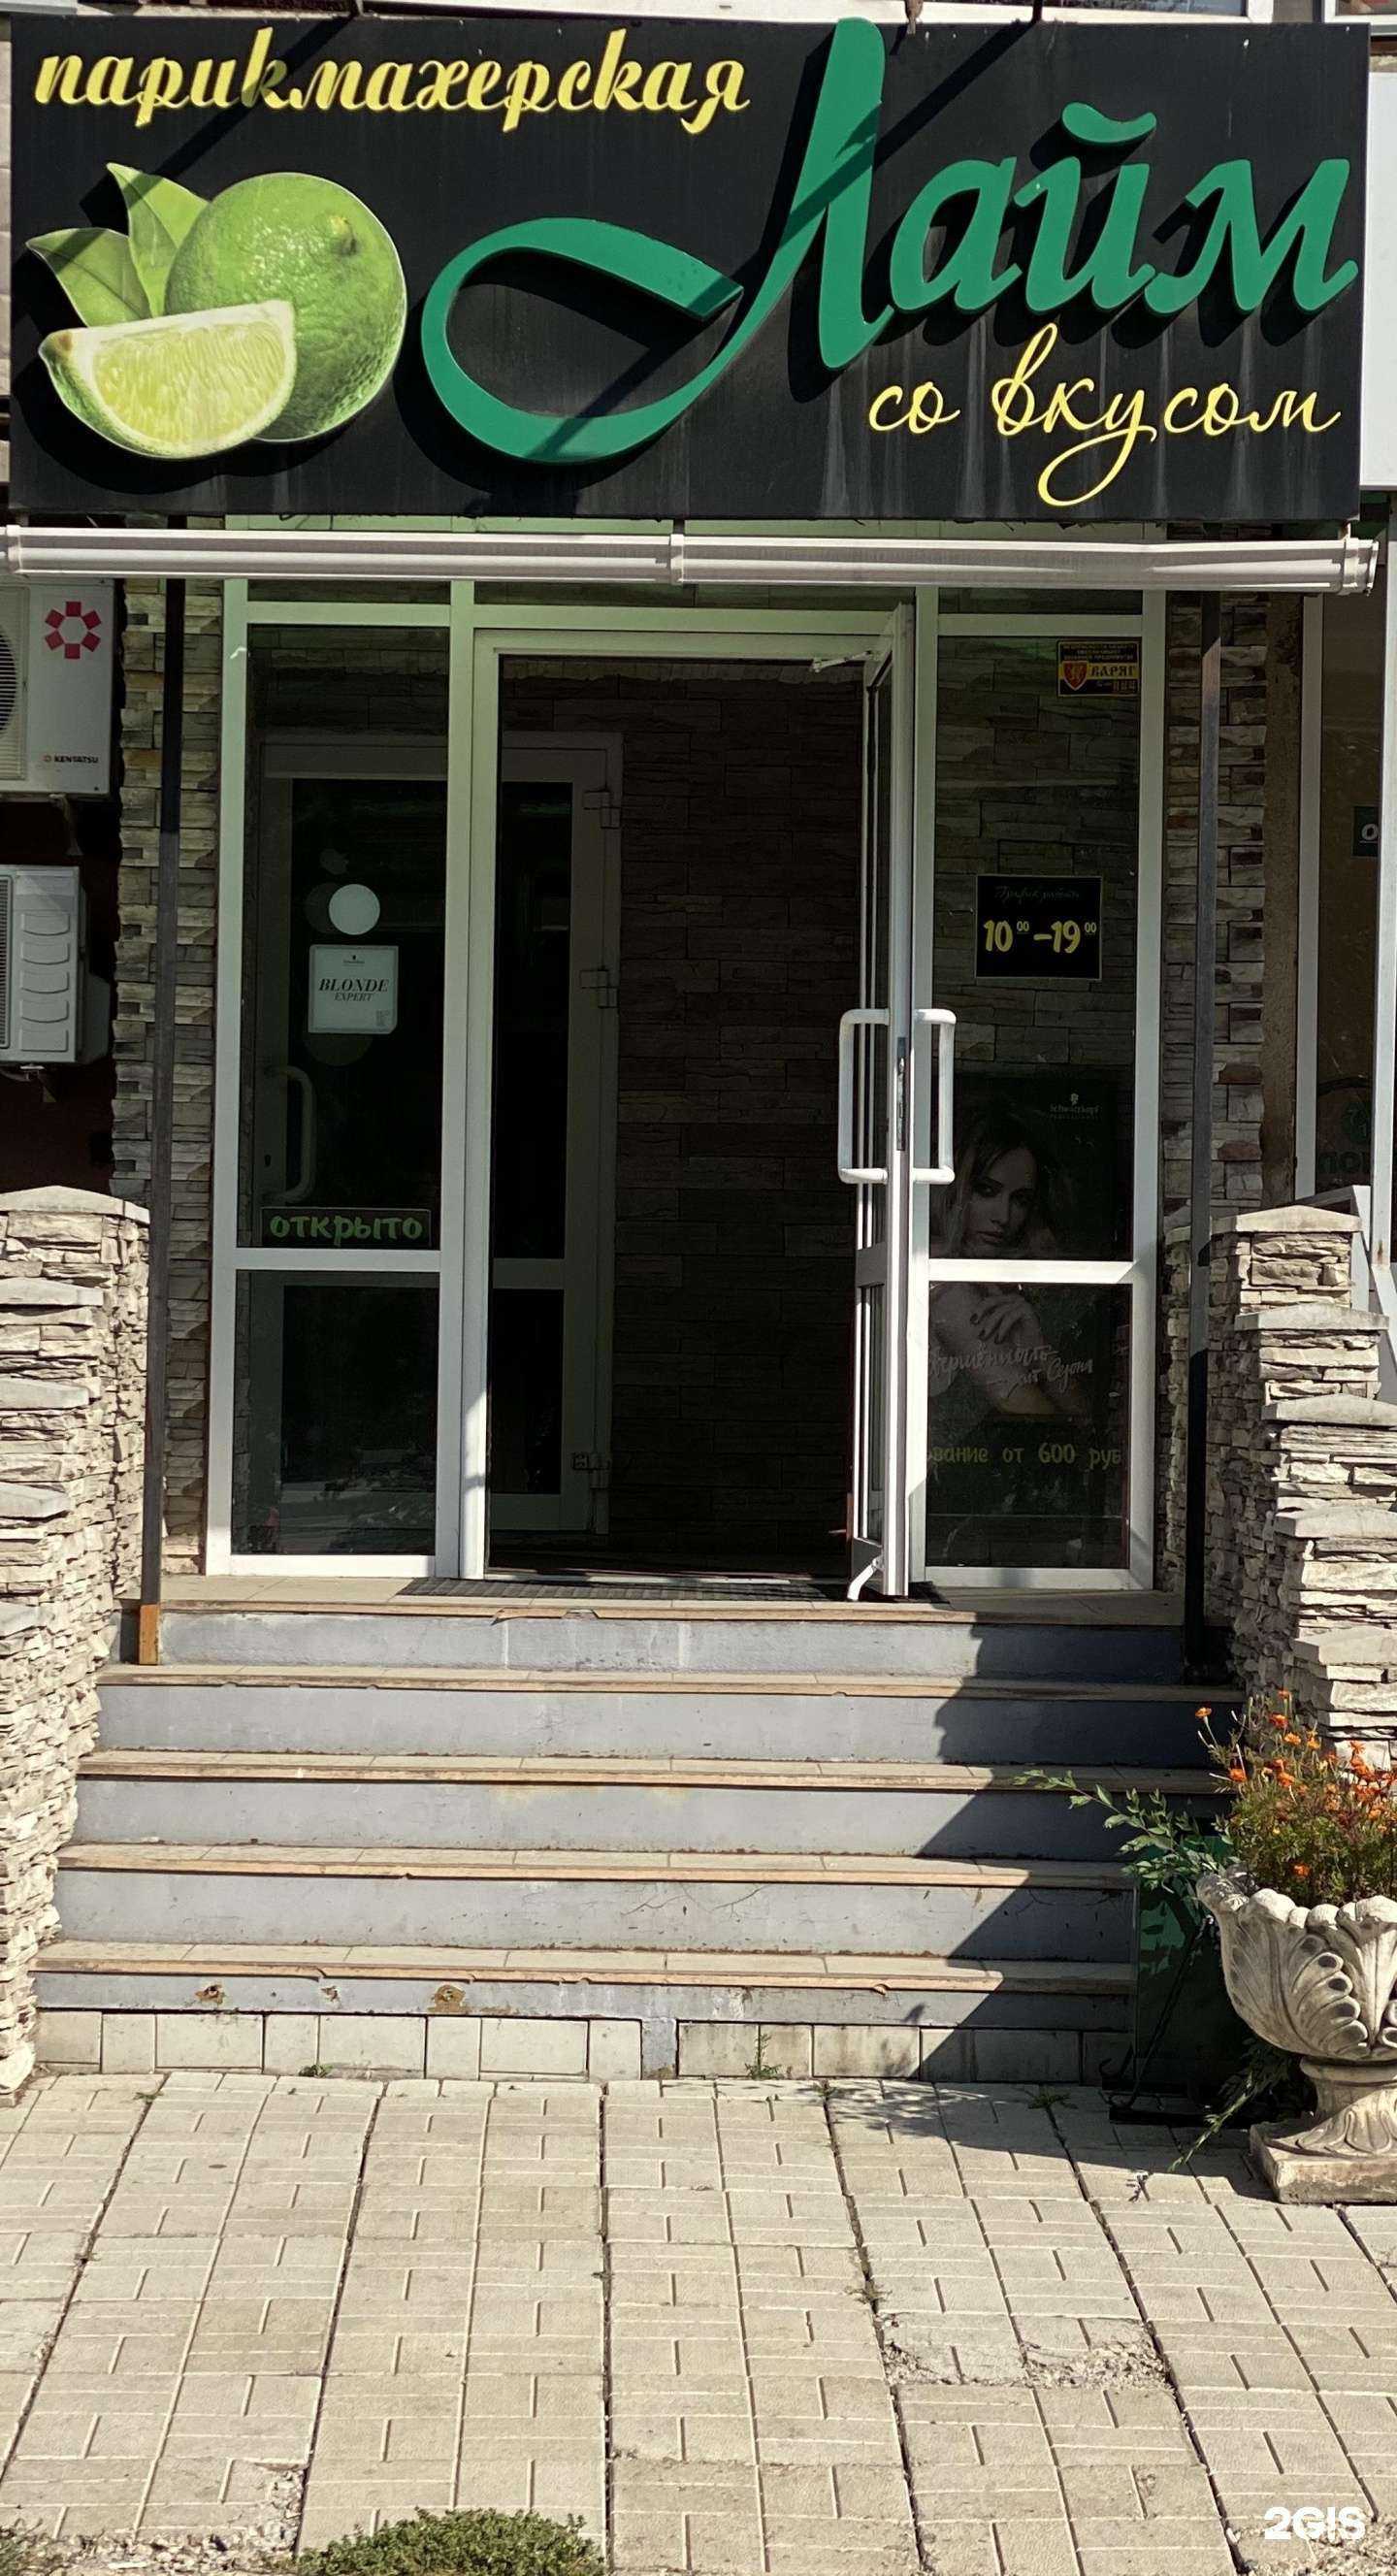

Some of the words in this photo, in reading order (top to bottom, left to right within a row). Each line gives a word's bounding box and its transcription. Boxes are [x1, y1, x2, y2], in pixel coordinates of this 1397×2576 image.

[34, 27, 751, 135] парикмахерская
[421, 17, 1358, 464] Лайм
[868, 381, 960, 436] со
[991, 322, 1342, 507] вкусом
[318, 978, 389, 993] BLONDE
[334, 993, 374, 1002] EXPERT
[1001, 1446, 1025, 1464] от
[1037, 1442, 1076, 1465] 600
